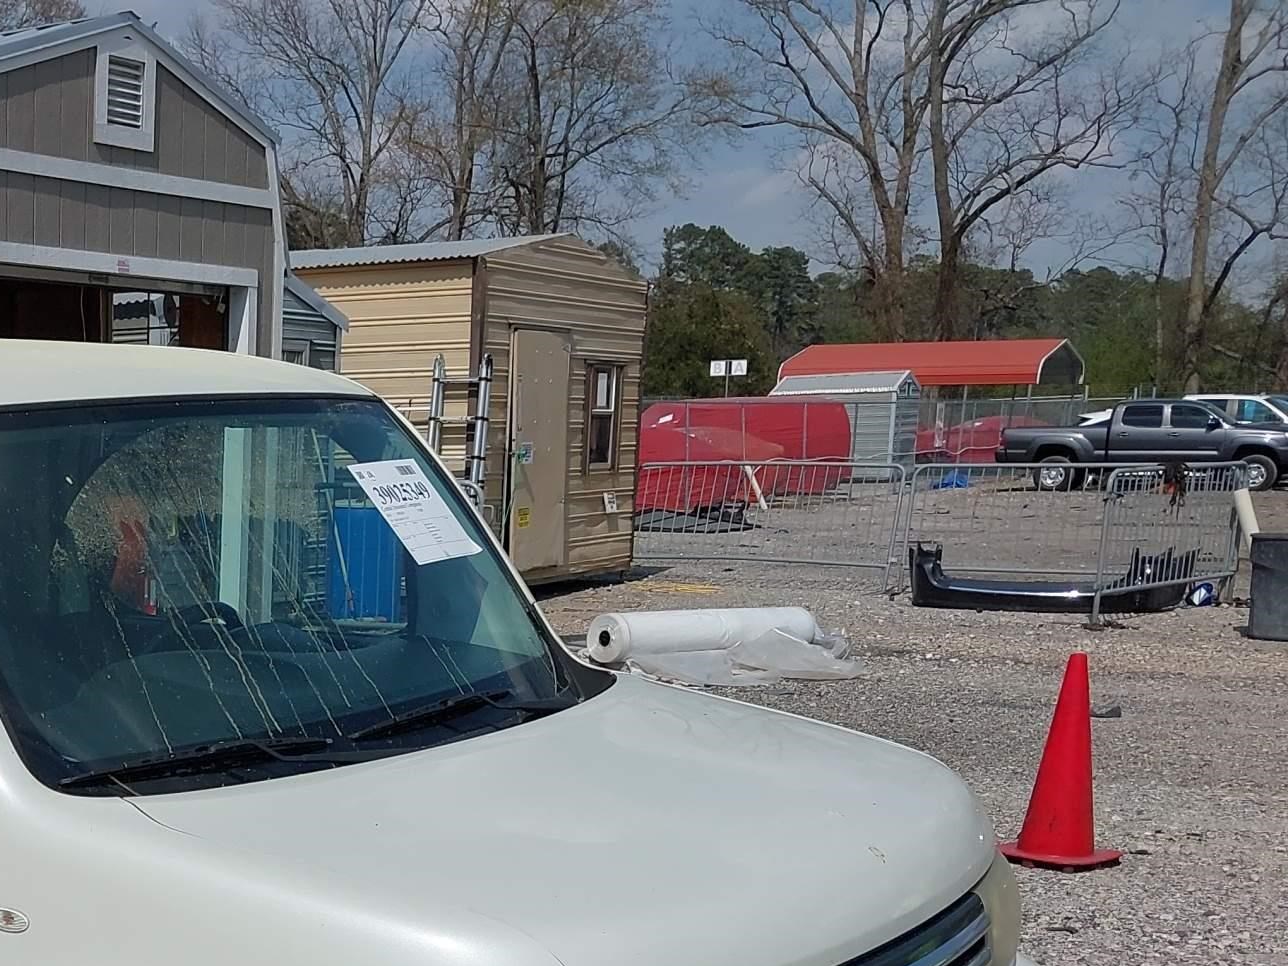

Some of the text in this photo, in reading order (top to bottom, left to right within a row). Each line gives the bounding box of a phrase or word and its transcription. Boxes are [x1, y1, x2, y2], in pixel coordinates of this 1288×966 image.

[713, 362, 722, 374] B
[734, 362, 744, 374] A
[373, 481, 431, 505] 39025349
